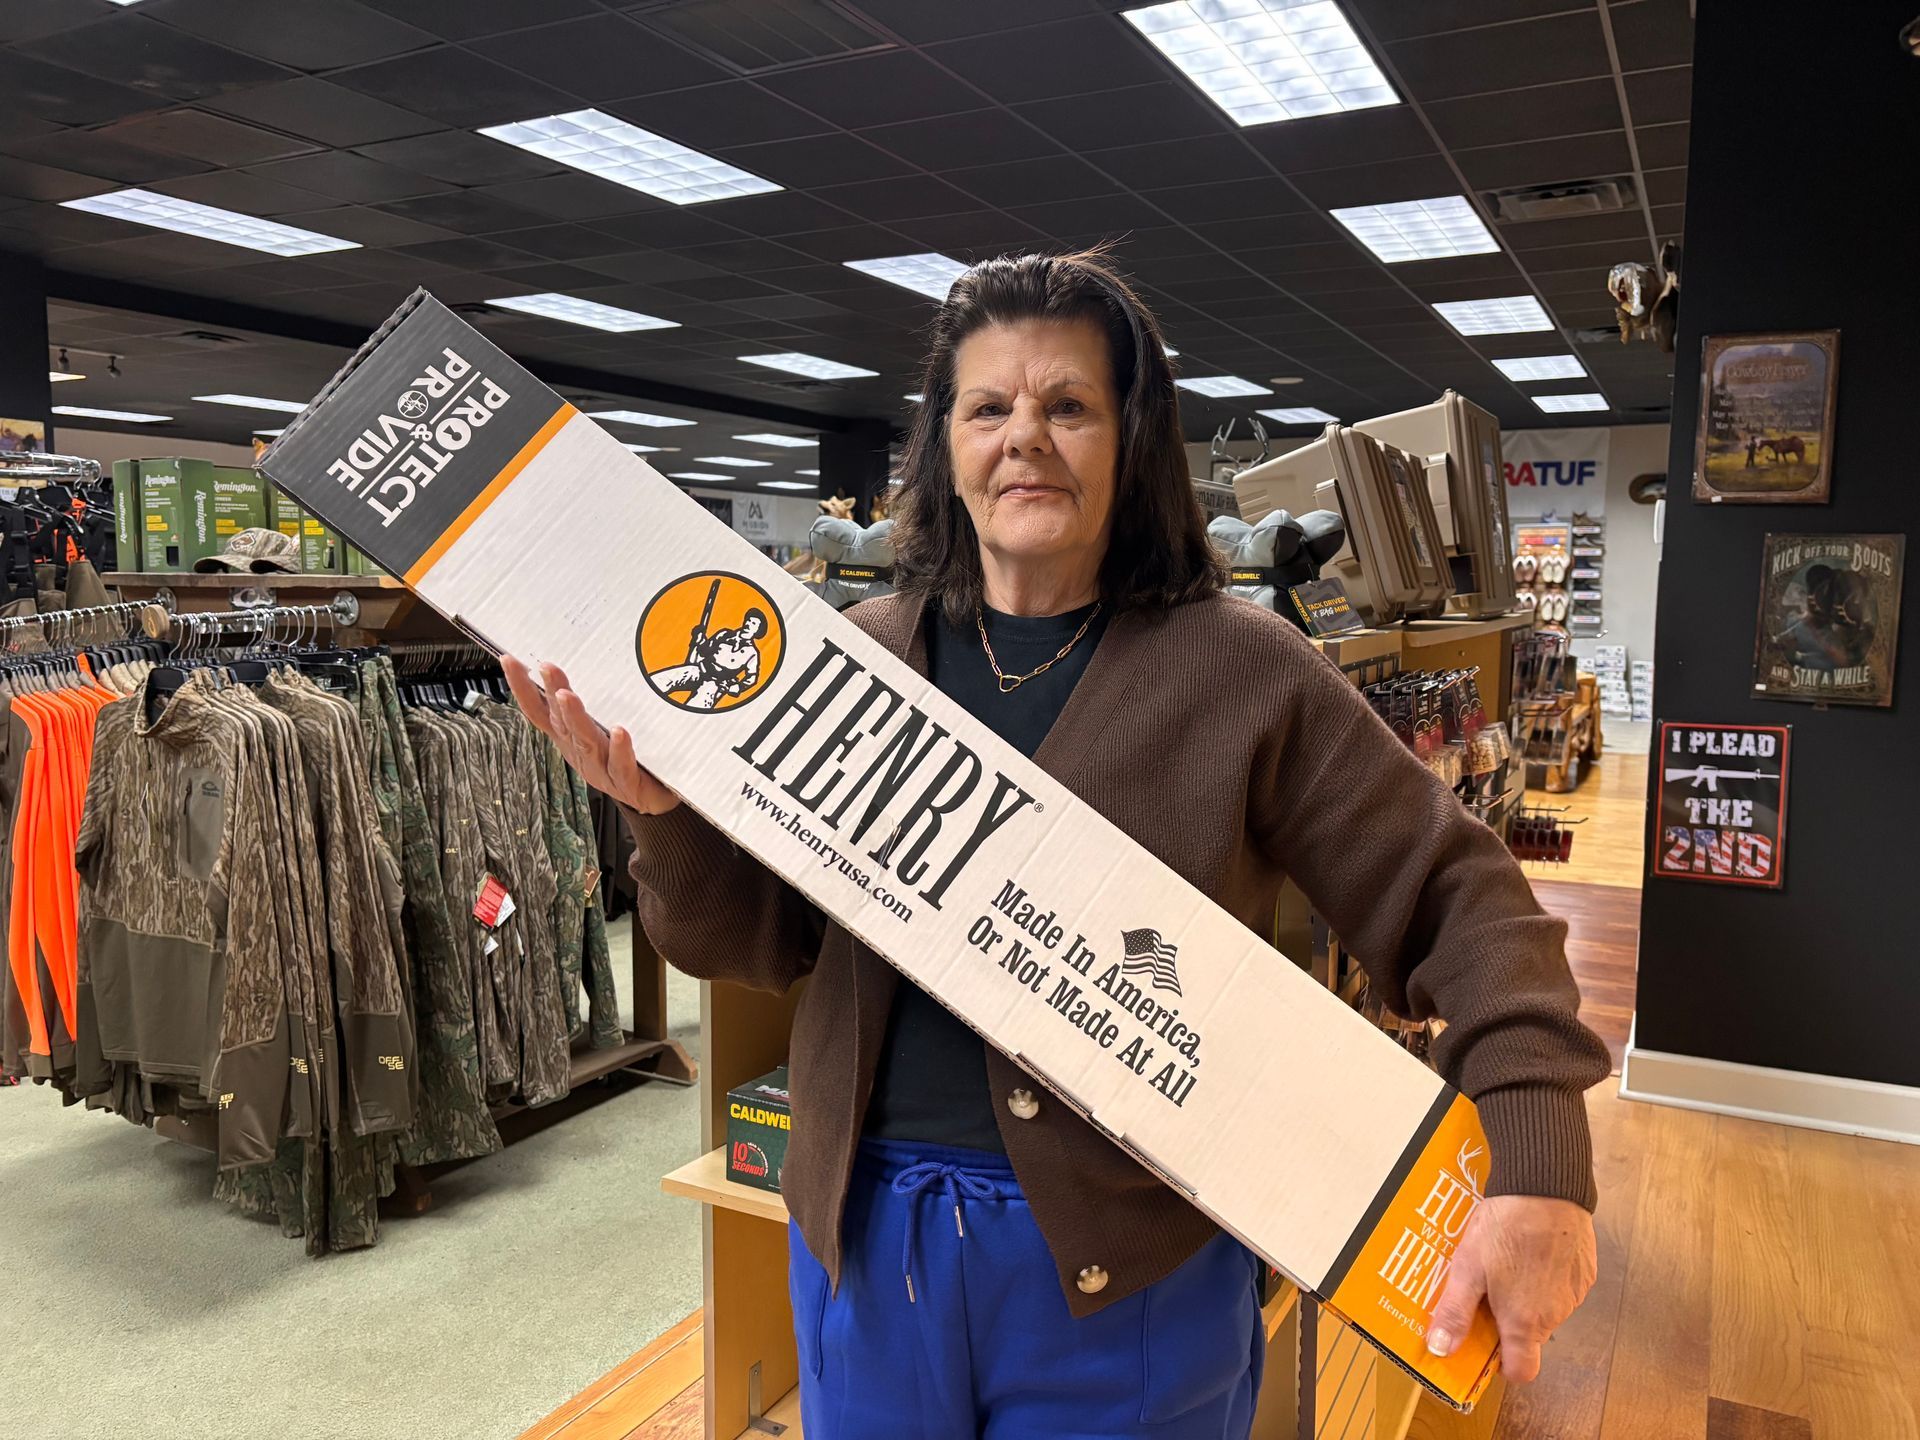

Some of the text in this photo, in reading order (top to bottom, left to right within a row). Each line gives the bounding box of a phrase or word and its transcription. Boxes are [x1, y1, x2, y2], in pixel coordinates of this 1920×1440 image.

[409, 423, 433, 442] &
[367, 377, 511, 528] PROTECT
[1772, 543, 1892, 576] KICK OFF YOUR BOOTS
[1307, 596, 1346, 611] TACK DRIVER
[1771, 665, 1871, 688] AND STAY A WHILE
[1672, 730, 1776, 757] I PLEAD
[731, 637, 1036, 911] HENRY
[1685, 797, 1753, 827] THE
[740, 781, 914, 924] www.henryusa.com
[1663, 826, 1772, 878] 2ND
[991, 879, 1201, 1068] Made In America,
[967, 915, 1197, 1107] Or Not Made At All
[730, 1103, 790, 1131] CALDWE
[733, 1141, 748, 1163] 10
[732, 1161, 765, 1178] SECONDS
[1415, 1168, 1480, 1238] HU
[1420, 1222, 1455, 1255] WIT
[1377, 1226, 1451, 1317] HEN
[1378, 1295, 1427, 1338] HenryUS
